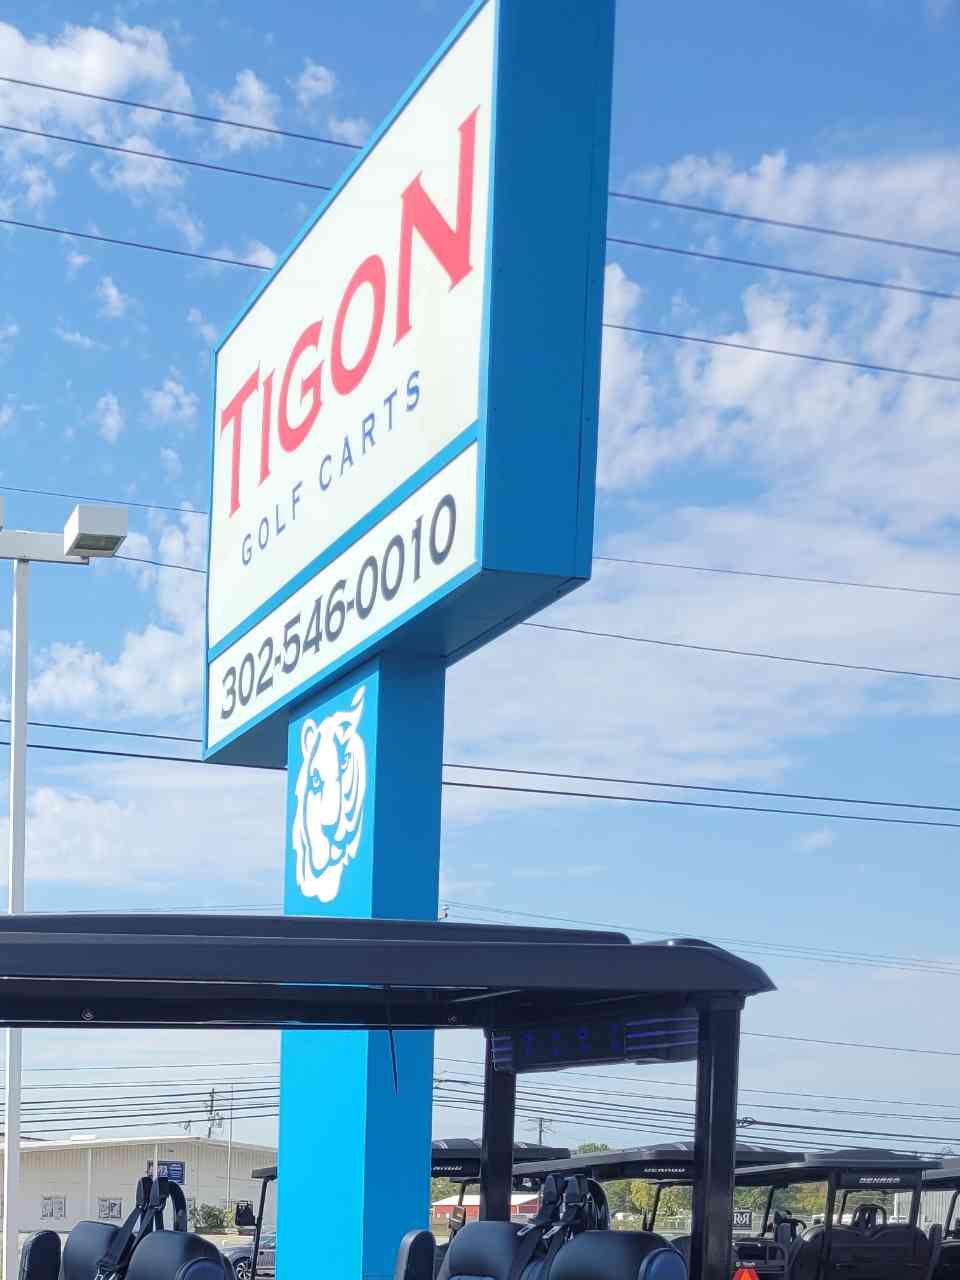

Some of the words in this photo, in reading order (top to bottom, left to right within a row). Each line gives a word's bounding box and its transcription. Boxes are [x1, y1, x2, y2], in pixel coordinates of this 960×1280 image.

[220, 104, 481, 518] TIGON
[241, 481, 303, 566] GOLF
[318, 370, 421, 492] CARTS
[220, 493, 457, 720] 302-546-0010
